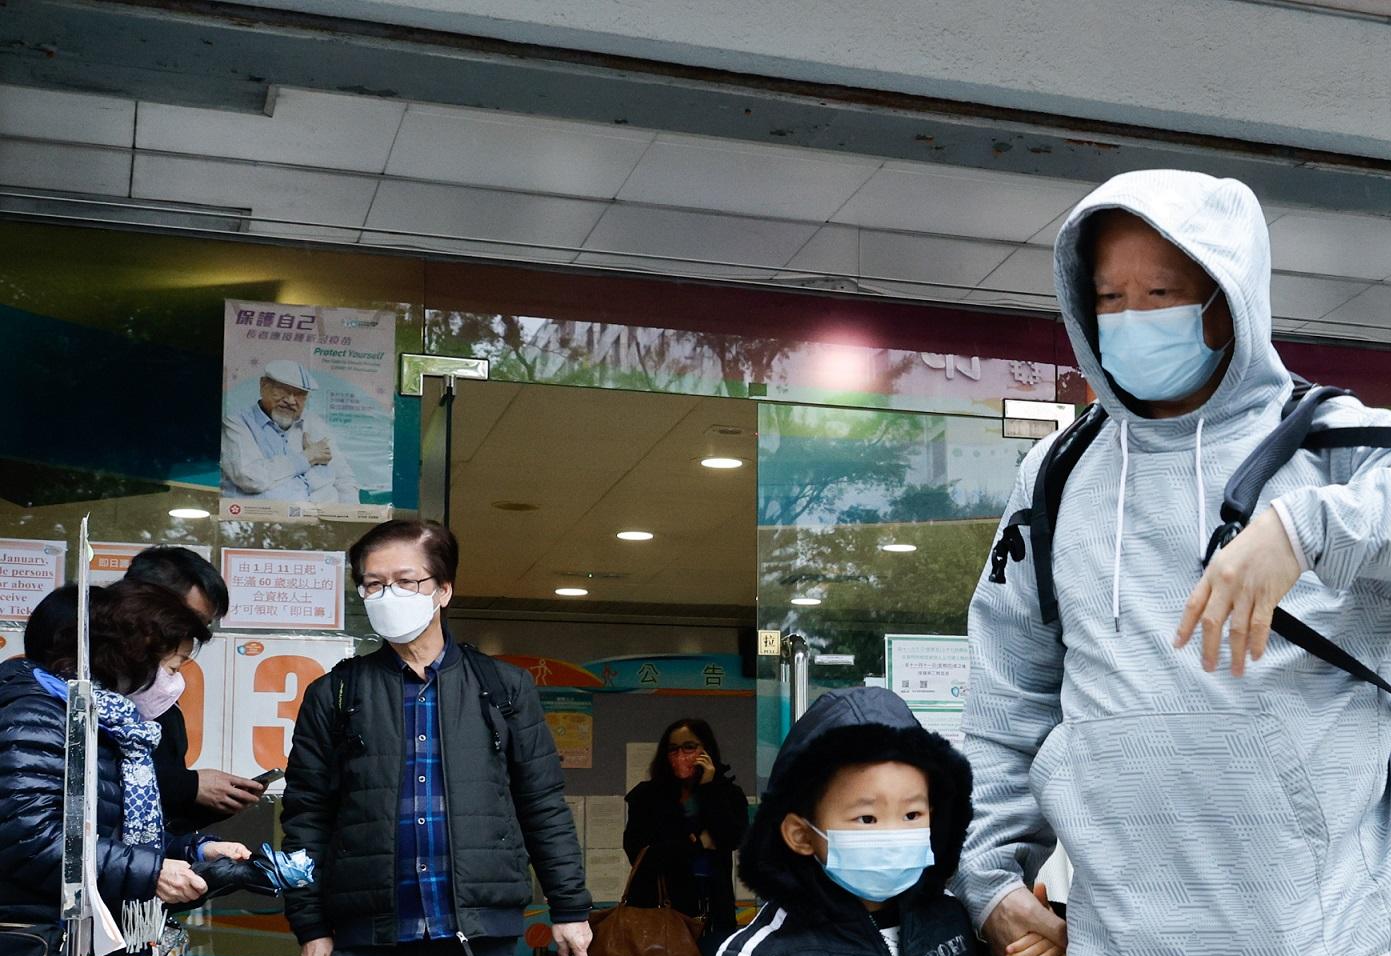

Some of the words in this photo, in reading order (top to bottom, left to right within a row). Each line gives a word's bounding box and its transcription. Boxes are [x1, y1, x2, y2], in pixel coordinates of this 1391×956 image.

[235, 309, 316, 331] 保護自己
[313, 347, 346, 358] Protect
[348, 350, 384, 361] Yourself
[12, 569, 54, 577] persons
[12, 580, 44, 589] above
